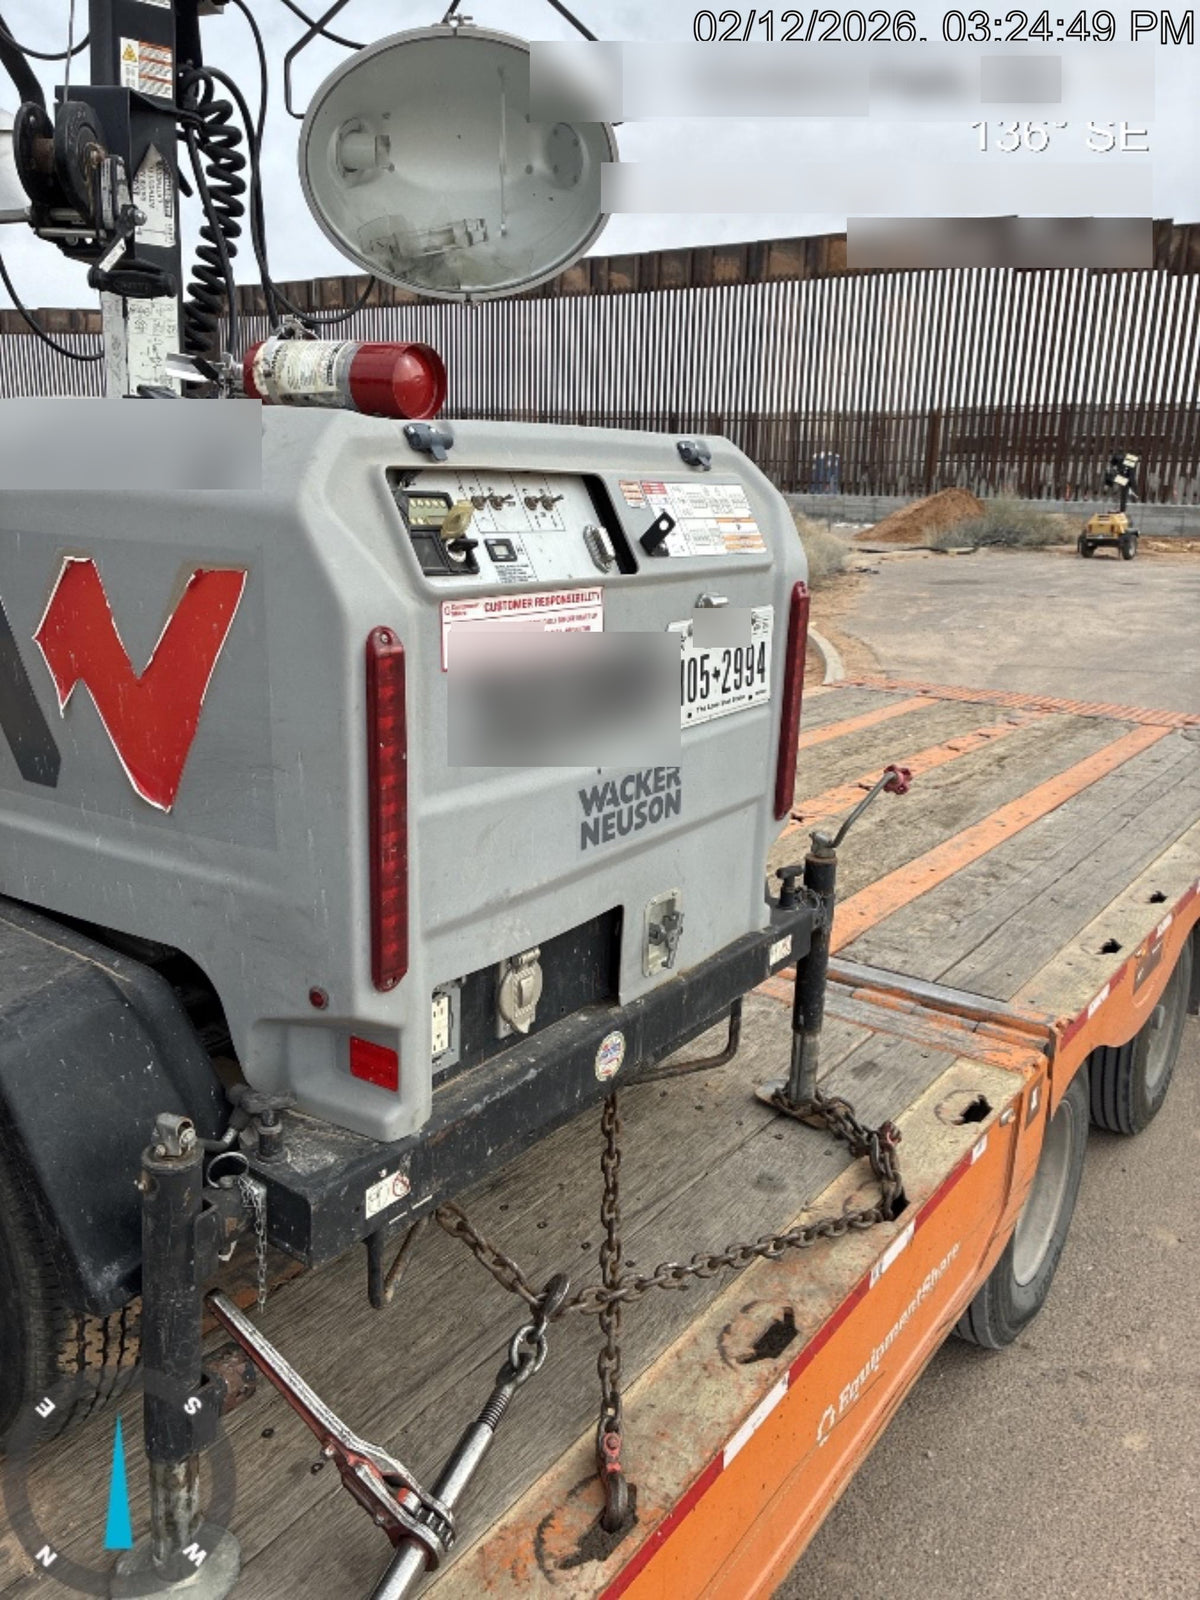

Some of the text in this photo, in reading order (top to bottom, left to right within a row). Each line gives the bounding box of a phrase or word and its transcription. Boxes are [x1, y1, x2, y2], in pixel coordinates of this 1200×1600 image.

[484, 598, 533, 613] CUSTOMER
[534, 591, 600, 608] RESPONSIBILITY
[578, 766, 682, 817] WACKER
[580, 788, 682, 851] NEUSON
